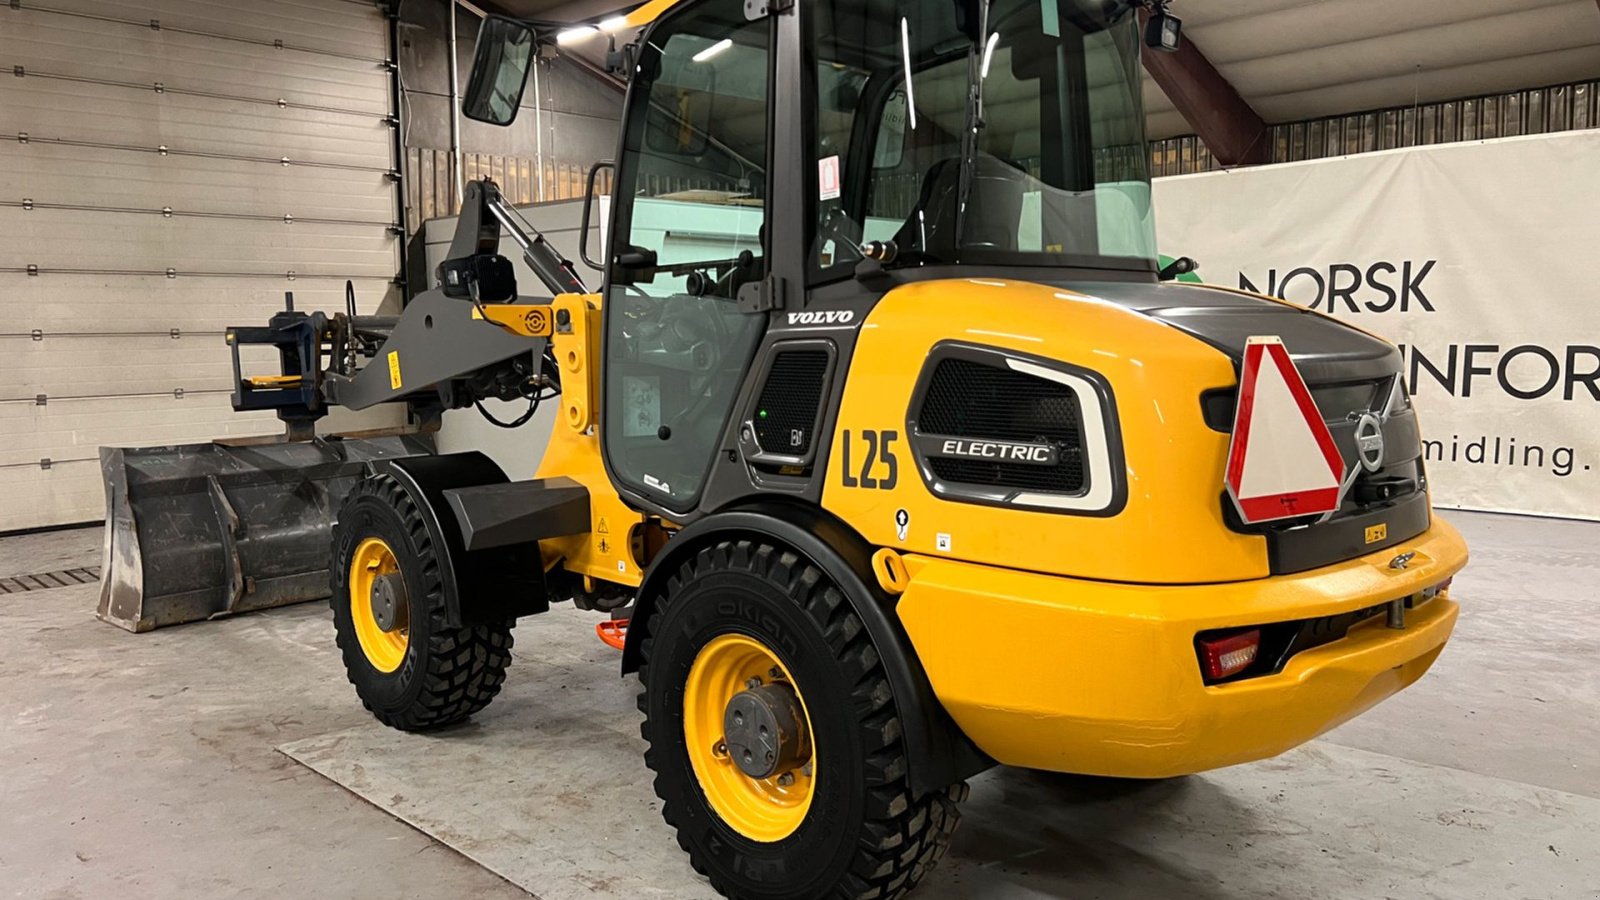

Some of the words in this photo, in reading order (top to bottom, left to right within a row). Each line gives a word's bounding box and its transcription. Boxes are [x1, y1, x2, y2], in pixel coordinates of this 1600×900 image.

[787, 310, 854, 325] VOLVO
[842, 429, 898, 490] L25
[942, 440, 1050, 462] ELECTRIC
